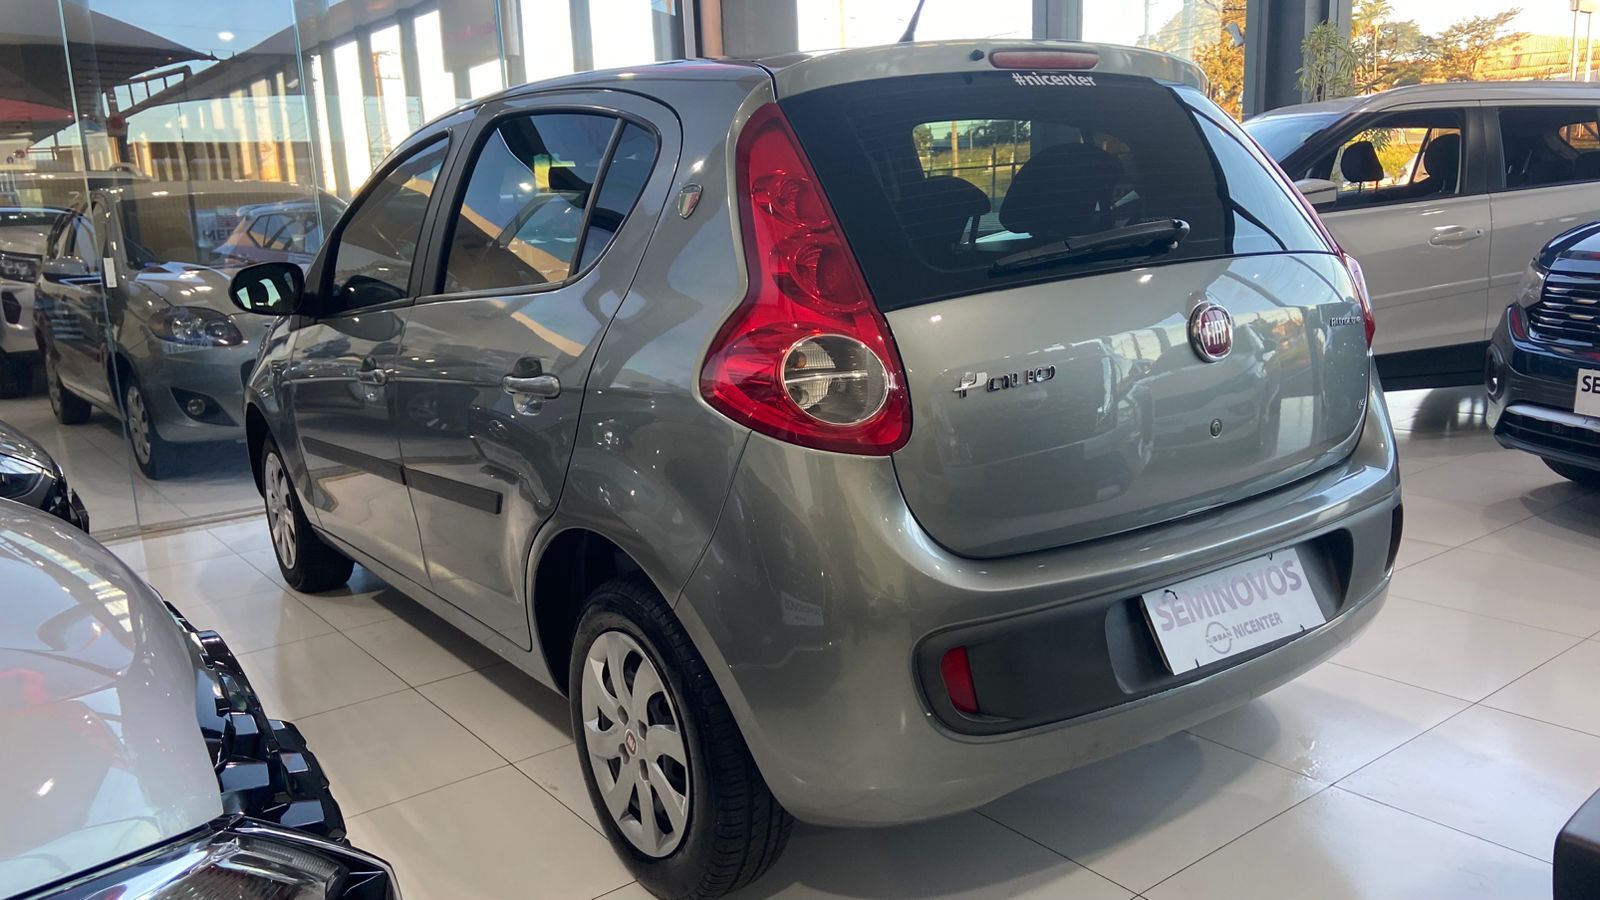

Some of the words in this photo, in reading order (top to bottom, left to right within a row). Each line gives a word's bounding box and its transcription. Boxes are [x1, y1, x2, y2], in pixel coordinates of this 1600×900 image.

[1012, 71, 1096, 87] #nicenter
[1204, 319, 1228, 346] FIAT
[1154, 559, 1303, 632] SEMINOVOS
[1206, 632, 1232, 644] NISSAN
[1232, 612, 1283, 639] NICENTER
